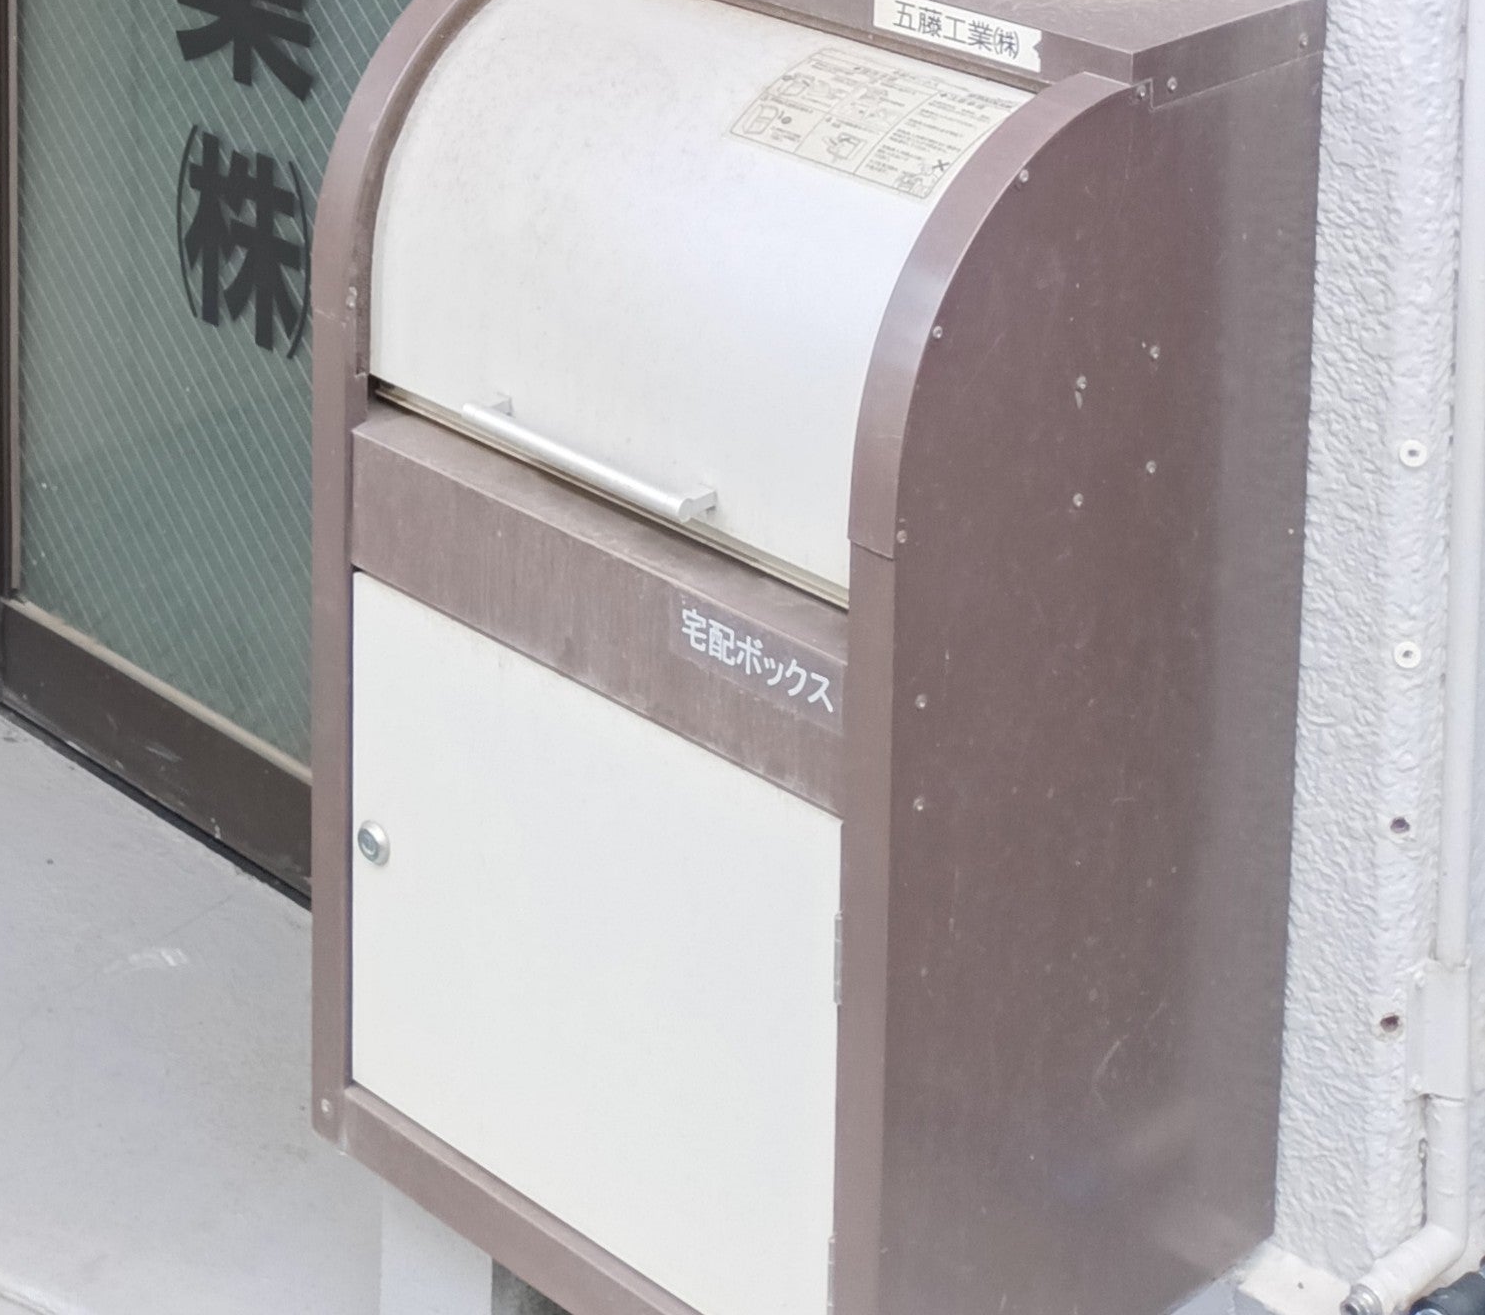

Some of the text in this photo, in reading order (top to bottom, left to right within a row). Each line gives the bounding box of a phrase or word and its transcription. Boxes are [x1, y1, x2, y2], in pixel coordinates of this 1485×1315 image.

[681, 607, 835, 715] 宅配ボックス
